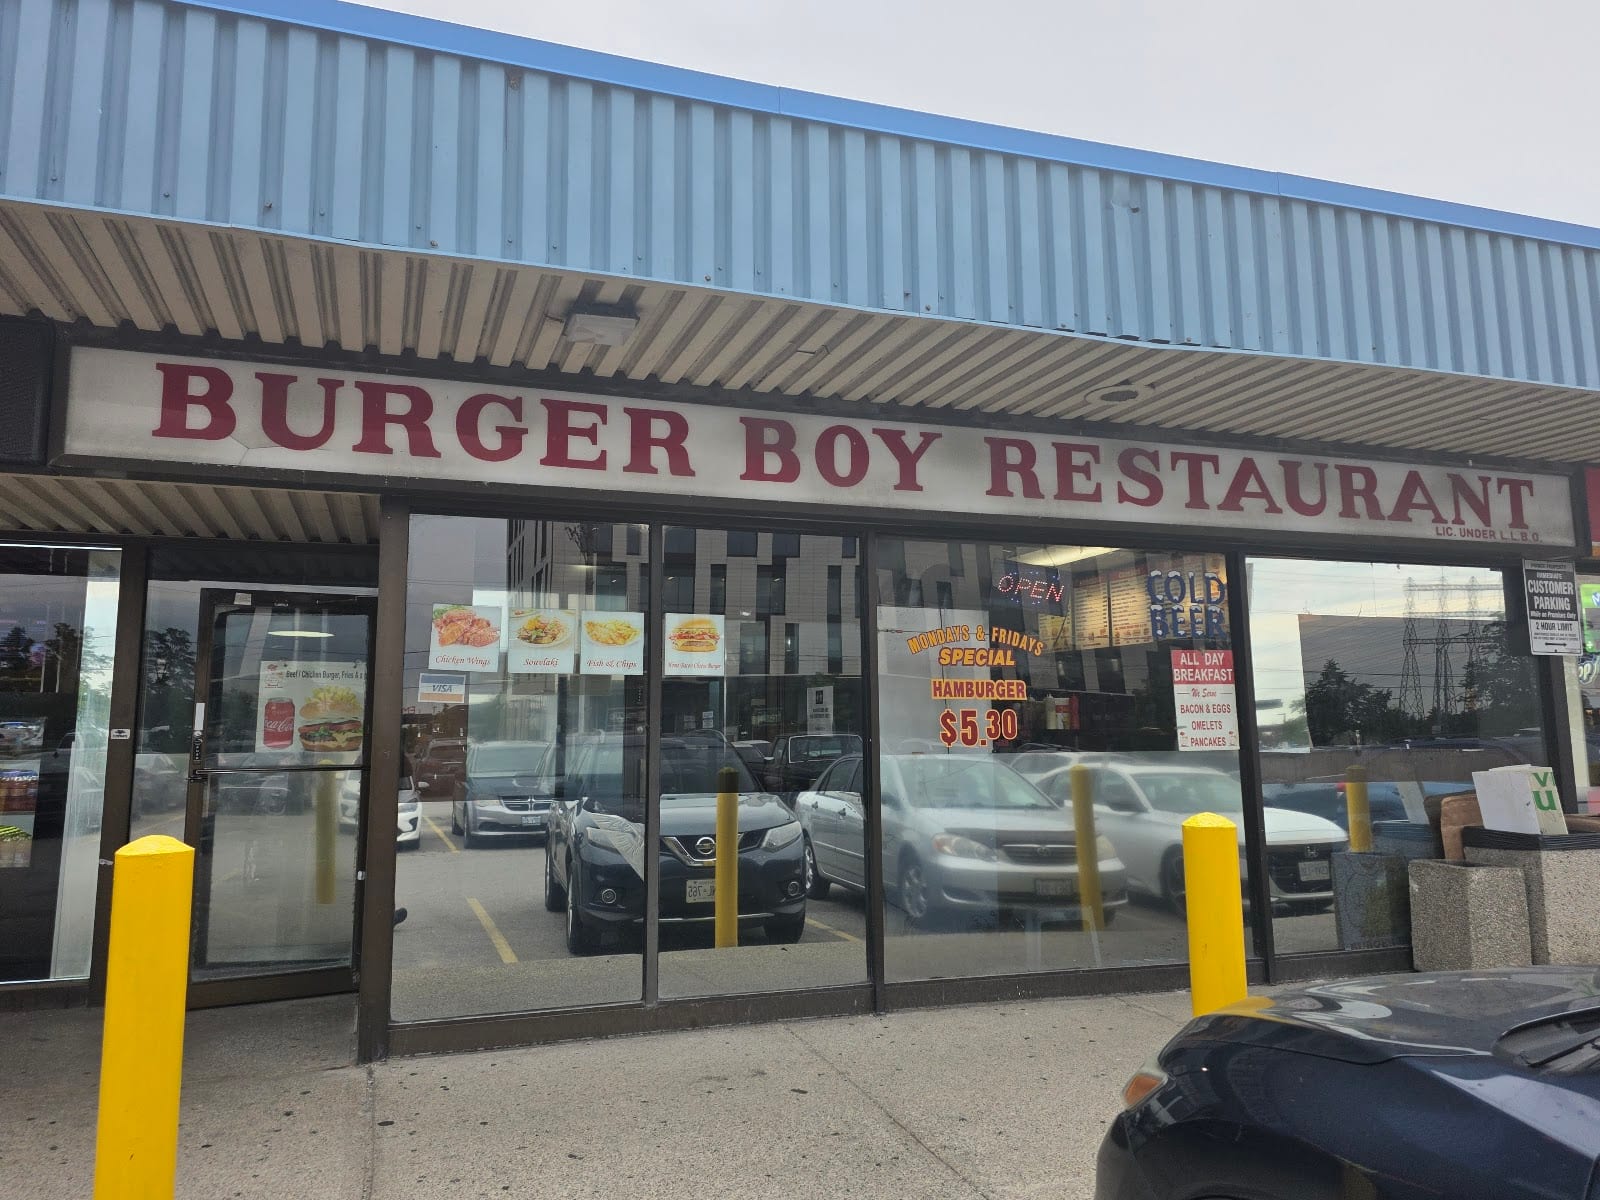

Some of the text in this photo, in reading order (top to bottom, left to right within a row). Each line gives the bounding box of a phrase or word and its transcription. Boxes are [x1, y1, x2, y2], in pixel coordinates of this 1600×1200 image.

[152, 361, 1534, 529] BURGER BOY RESTAURANT
[1435, 526, 1457, 537] LIC.
[1459, 527, 1497, 540] UNDER
[997, 575, 1065, 602] OPEN
[1147, 570, 1226, 605] COLD
[1527, 579, 1574, 595] CUSTOMER
[1533, 595, 1571, 611] PARKING
[1150, 604, 1229, 639] BEER
[1535, 621, 1573, 632] 2 HOUR LIMIT
[907, 625, 970, 655] MONDAYS
[976, 625, 986, 641] &
[991, 626, 1045, 656] FRIDAYS
[434, 655, 491, 667] Chicken Wings
[522, 656, 559, 667] Souvlaki
[586, 658, 604, 667] Fish
[615, 659, 638, 669] Chips
[938, 647, 1017, 667] SPECIAL
[1180, 653, 1225, 666] ALL DAY
[285, 670, 298, 679] Beef
[301, 670, 322, 679] Chicken
[341, 670, 354, 679] Fries
[1173, 668, 1233, 682] BREAKFAST
[432, 684, 453, 693] VISA
[932, 680, 1026, 699] HAMBURGER
[1180, 704, 1232, 714] BACON & EGGS
[939, 709, 1018, 747] $5.30
[1191, 720, 1223, 730] OMELETS
[1190, 737, 1227, 747] PANCAKES
